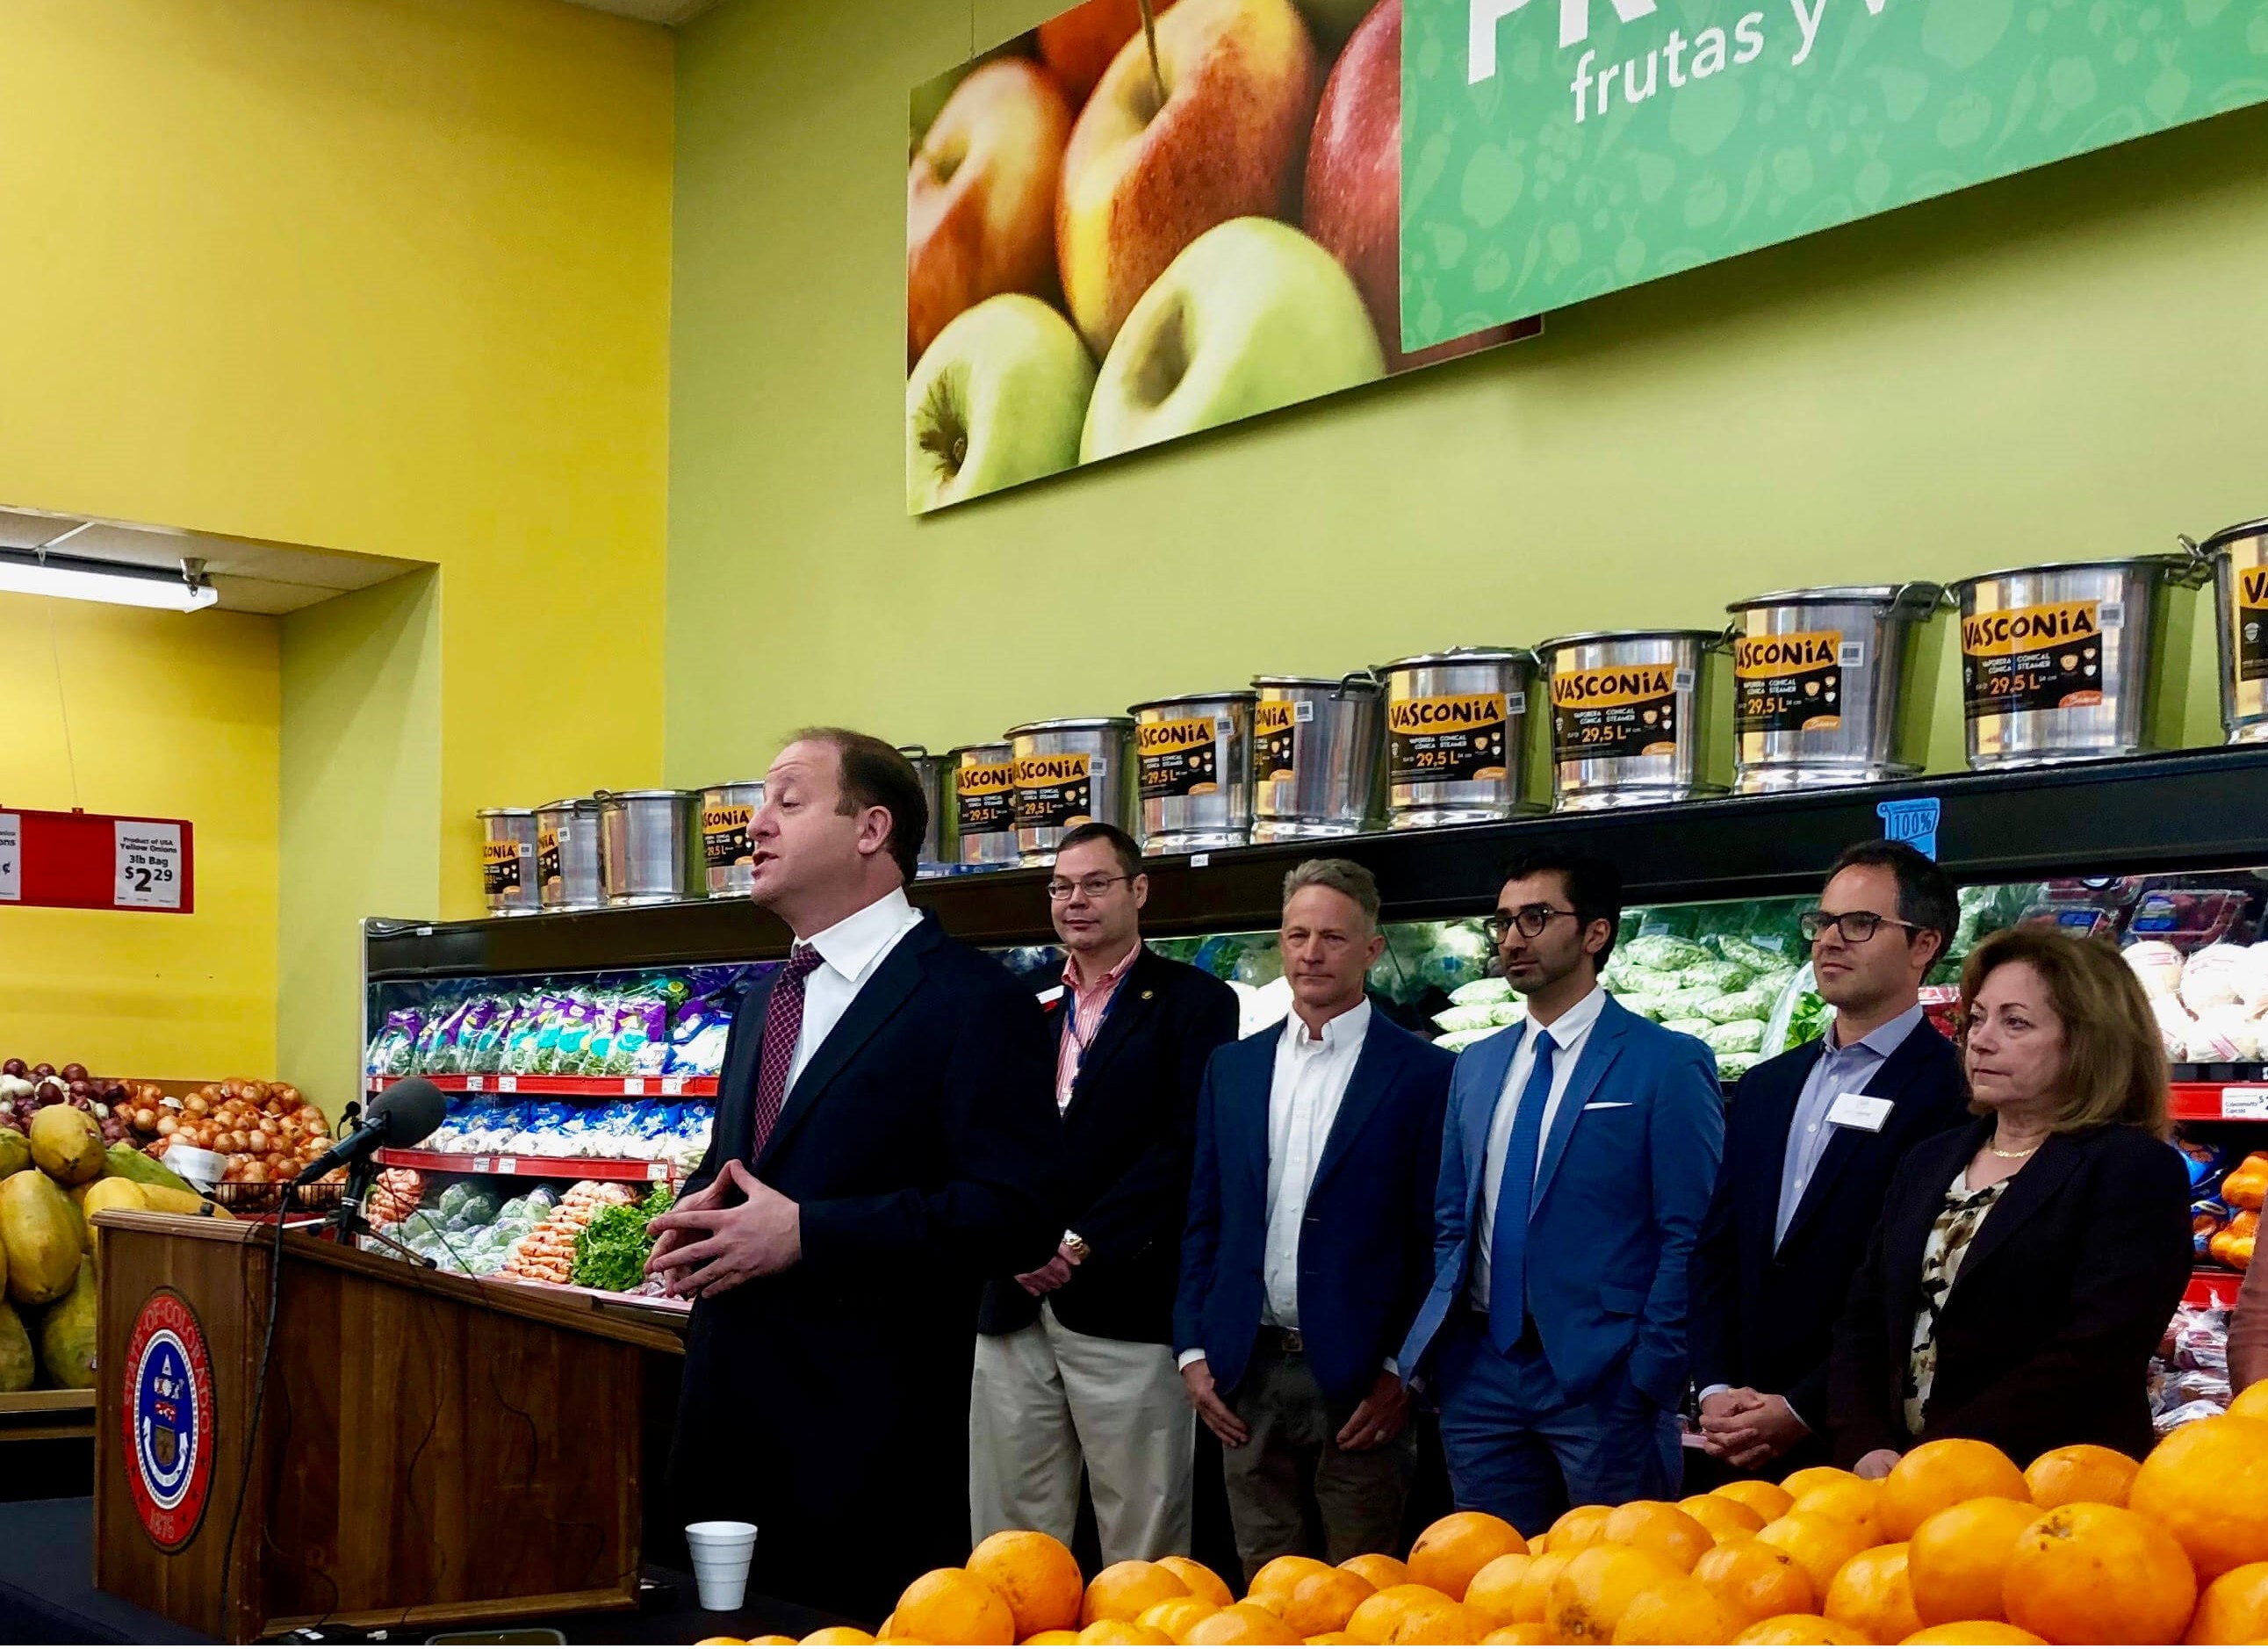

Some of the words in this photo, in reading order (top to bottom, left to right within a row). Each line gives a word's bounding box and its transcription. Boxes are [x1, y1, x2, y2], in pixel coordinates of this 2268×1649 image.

[1571, 11, 1764, 123] frutas
[1895, 811, 1932, 839] 100%
[150, 845, 177, 853] Onions
[129, 854, 146, 864] 3lb
[148, 856, 169, 868] Bag
